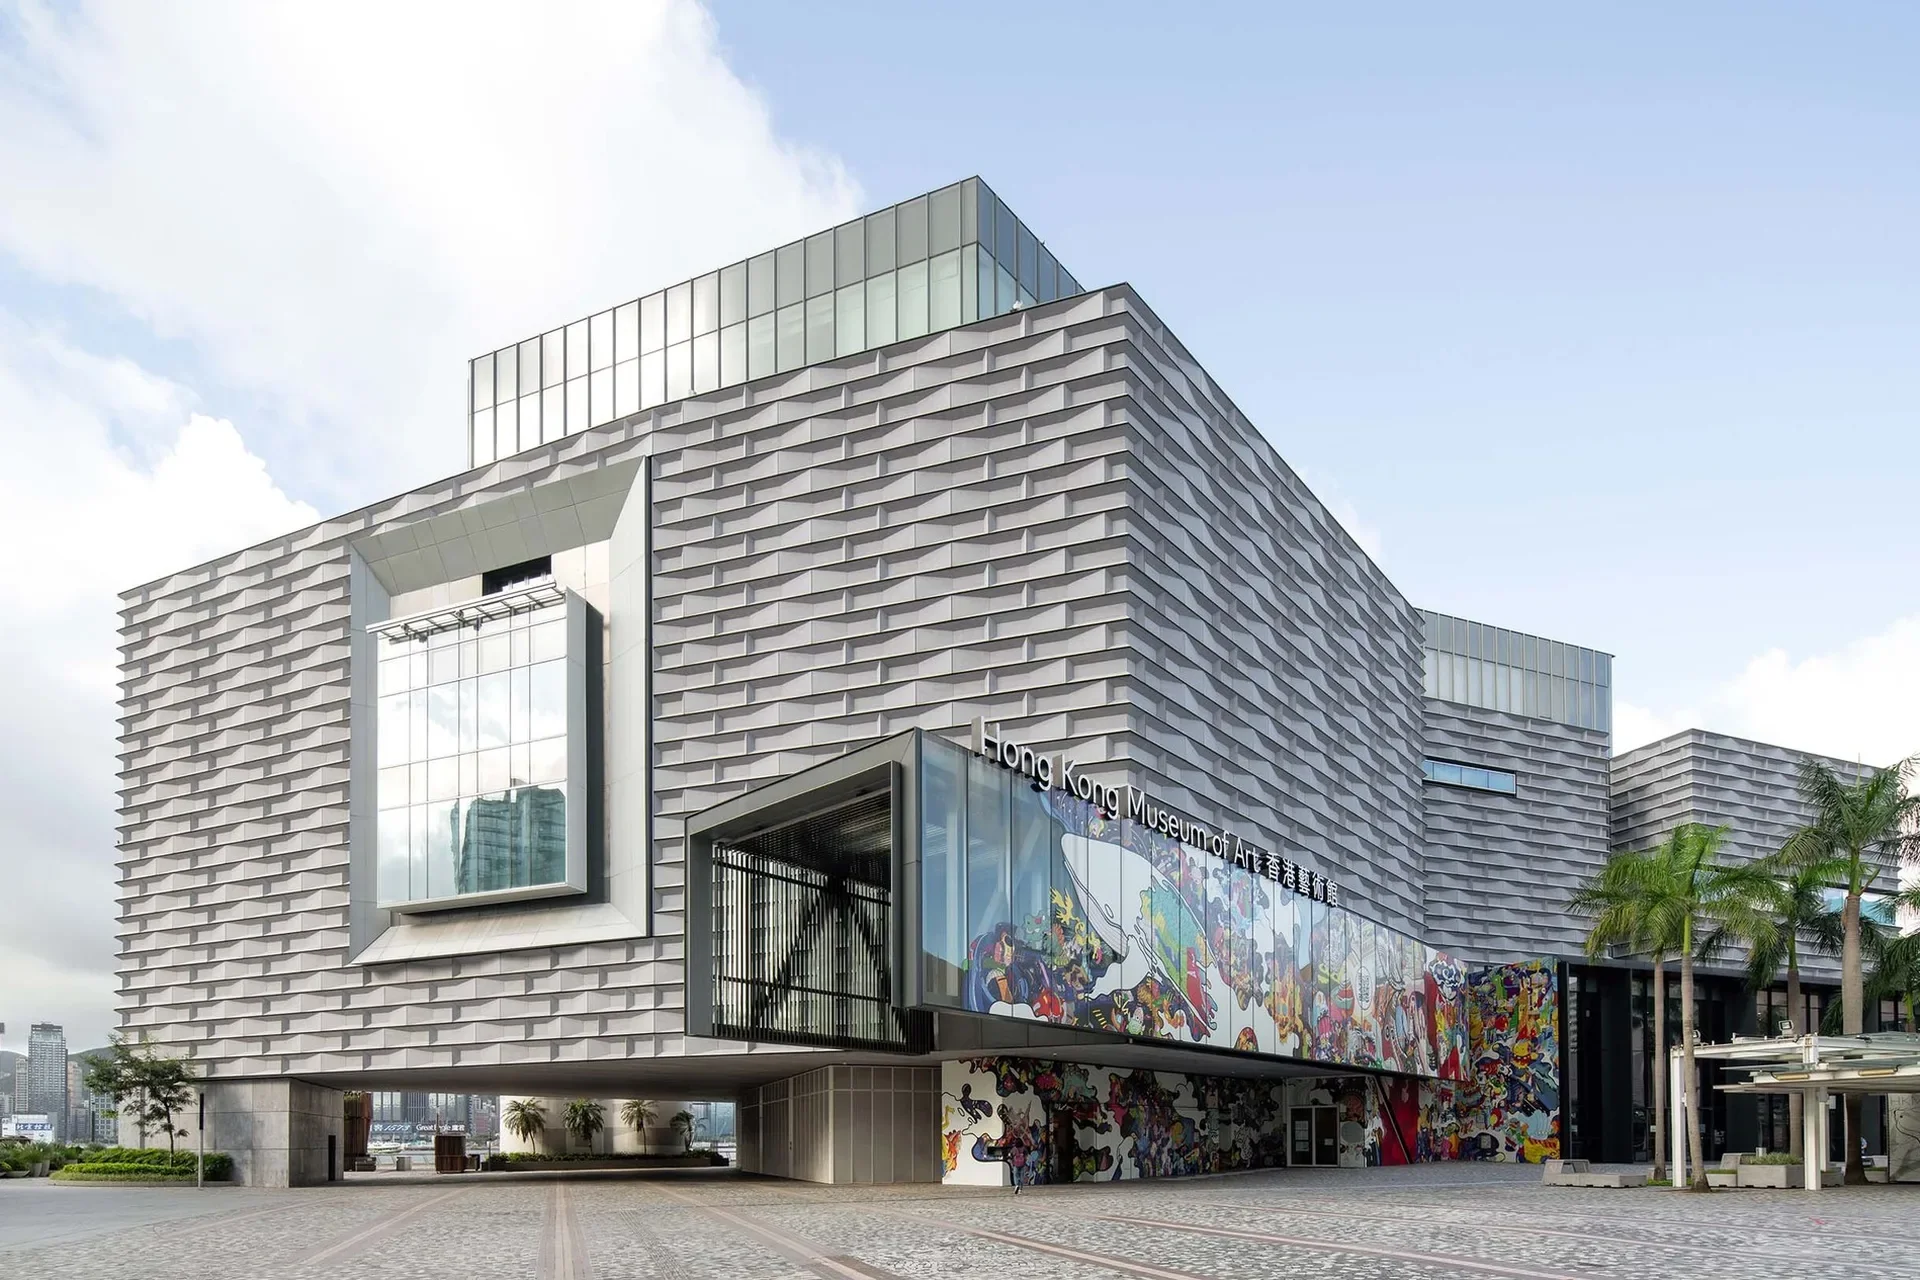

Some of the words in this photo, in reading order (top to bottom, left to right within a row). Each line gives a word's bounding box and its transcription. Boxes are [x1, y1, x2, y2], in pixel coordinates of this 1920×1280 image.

[980, 716, 1051, 791] Hong
[1062, 754, 1119, 820] Kong
[1128, 784, 1207, 850] Museum
[1212, 830, 1230, 859] of
[1234, 837, 1261, 873] Art
[1266, 851, 1338, 907] 香港藝術館
[415, 1123, 434, 1131] Great
